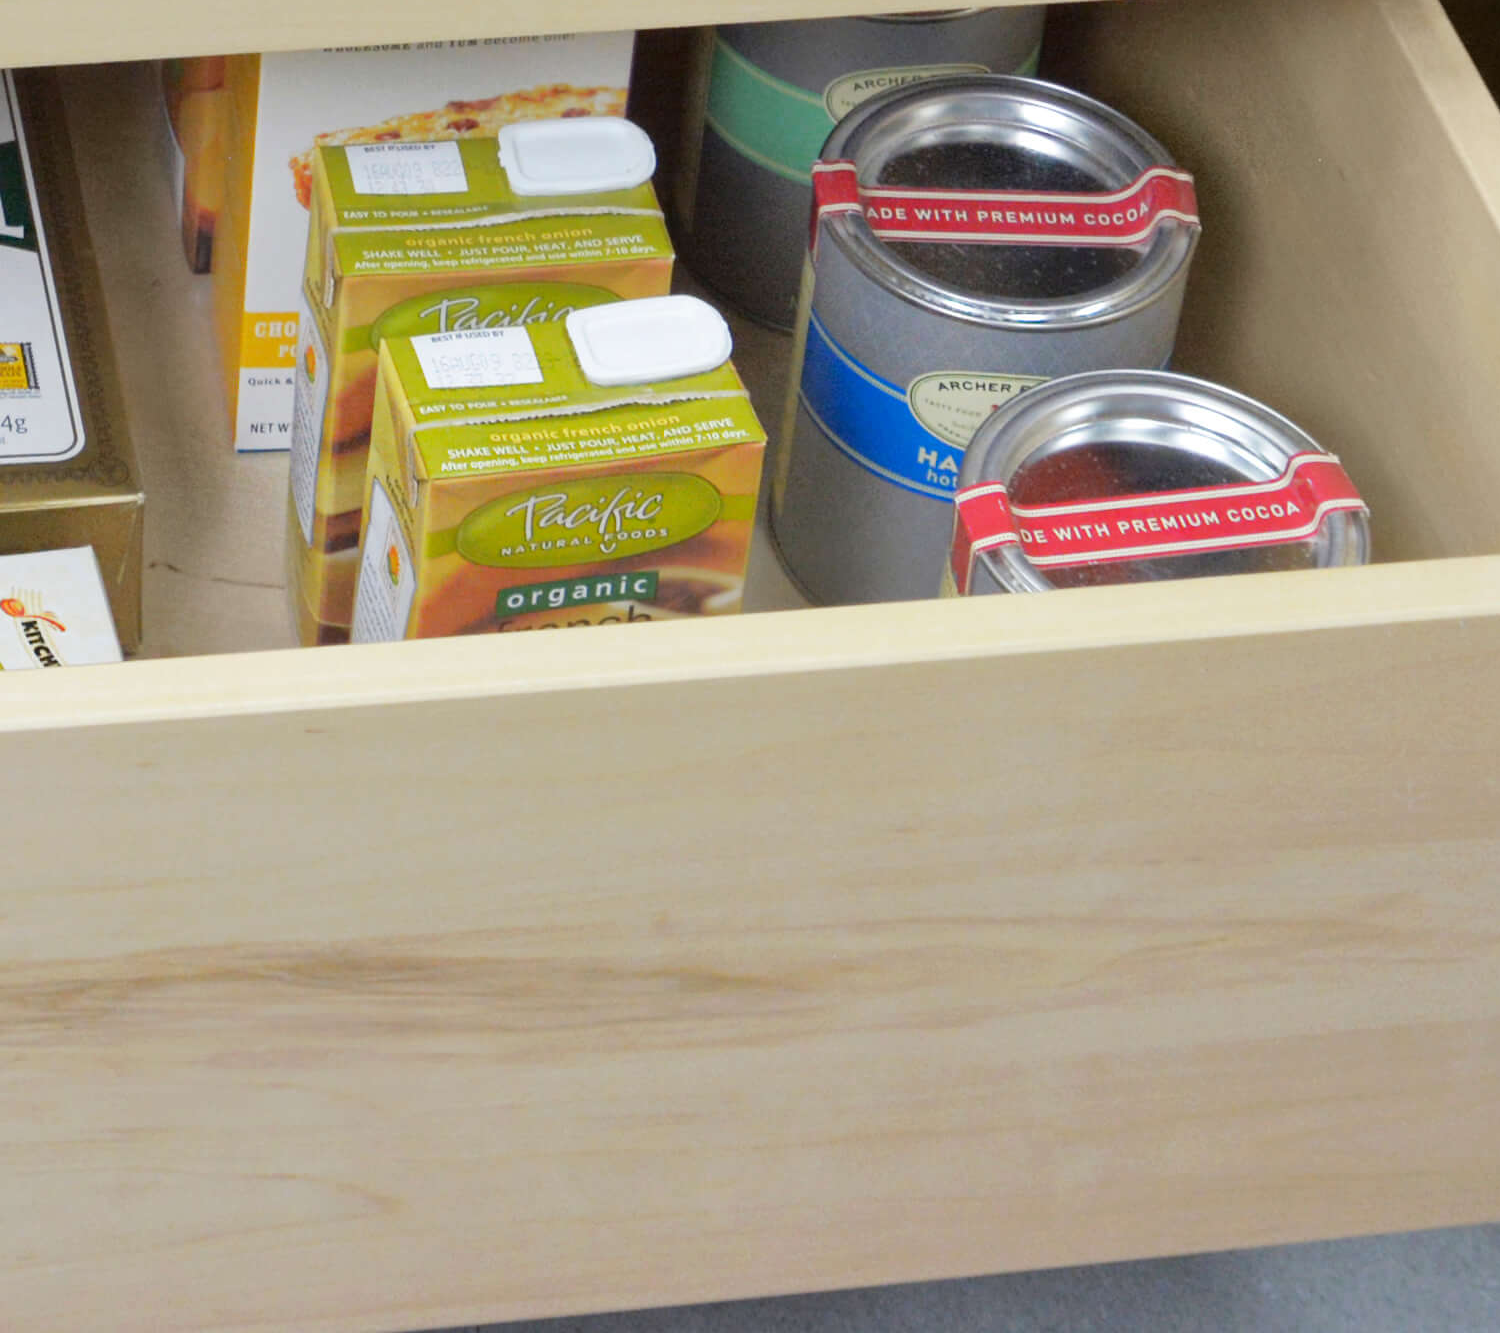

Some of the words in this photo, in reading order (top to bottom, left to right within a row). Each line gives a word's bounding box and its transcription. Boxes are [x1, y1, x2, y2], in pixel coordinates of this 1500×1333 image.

[344, 210, 369, 220] EASY
[373, 210, 387, 219] TO
[391, 209, 420, 219] POUR
[915, 209, 968, 223] WITH
[977, 210, 1075, 226] PREMIUM
[1084, 202, 1149, 226] COCOA
[362, 249, 405, 260] SHAKE
[408, 248, 441, 259] WELL
[459, 246, 489, 257] JUST
[575, 239, 603, 250] AND
[605, 234, 645, 246] SERVE
[405, 235, 475, 249] organic
[479, 231, 537, 245] french
[541, 227, 593, 241] onion
[354, 259, 381, 271] After
[384, 257, 431, 271] opening,
[432, 255, 459, 268] keep
[460, 252, 524, 266] refrigerated
[526, 252, 547, 262] and
[548, 251, 568, 261] use
[569, 248, 603, 259] within
[605, 245, 629, 257] 7-10
[248, 377, 281, 387] Quick
[938, 381, 1012, 393] ARCHER
[419, 404, 446, 415] EASY
[450, 403, 465, 412] TO
[467, 401, 498, 411] POUR
[250, 423, 274, 434] NET
[447, 446, 491, 460] SHAKE
[493, 444, 529, 456] WELL
[546, 440, 577, 452] JUST
[664, 426, 692, 439] AND
[695, 418, 734, 433] SERVE
[489, 430, 559, 445] organic
[562, 425, 622, 440] french
[626, 415, 681, 434] onion
[441, 460, 469, 472] After
[470, 457, 520, 471] opening,
[521, 454, 548, 466] keep
[549, 448, 615, 464] refrigerated
[616, 444, 637, 455] and
[638, 442, 659, 453] use
[659, 437, 694, 450] within
[696, 432, 720, 444] 7-10
[505, 486, 664, 542] Pacific
[1053, 522, 1111, 541] WITH
[1117, 511, 1220, 536] PREMIUM
[1227, 501, 1301, 522] COCOA
[501, 535, 593, 558] NATURAL
[604, 528, 669, 543] FOODS
[506, 576, 648, 608] organic
